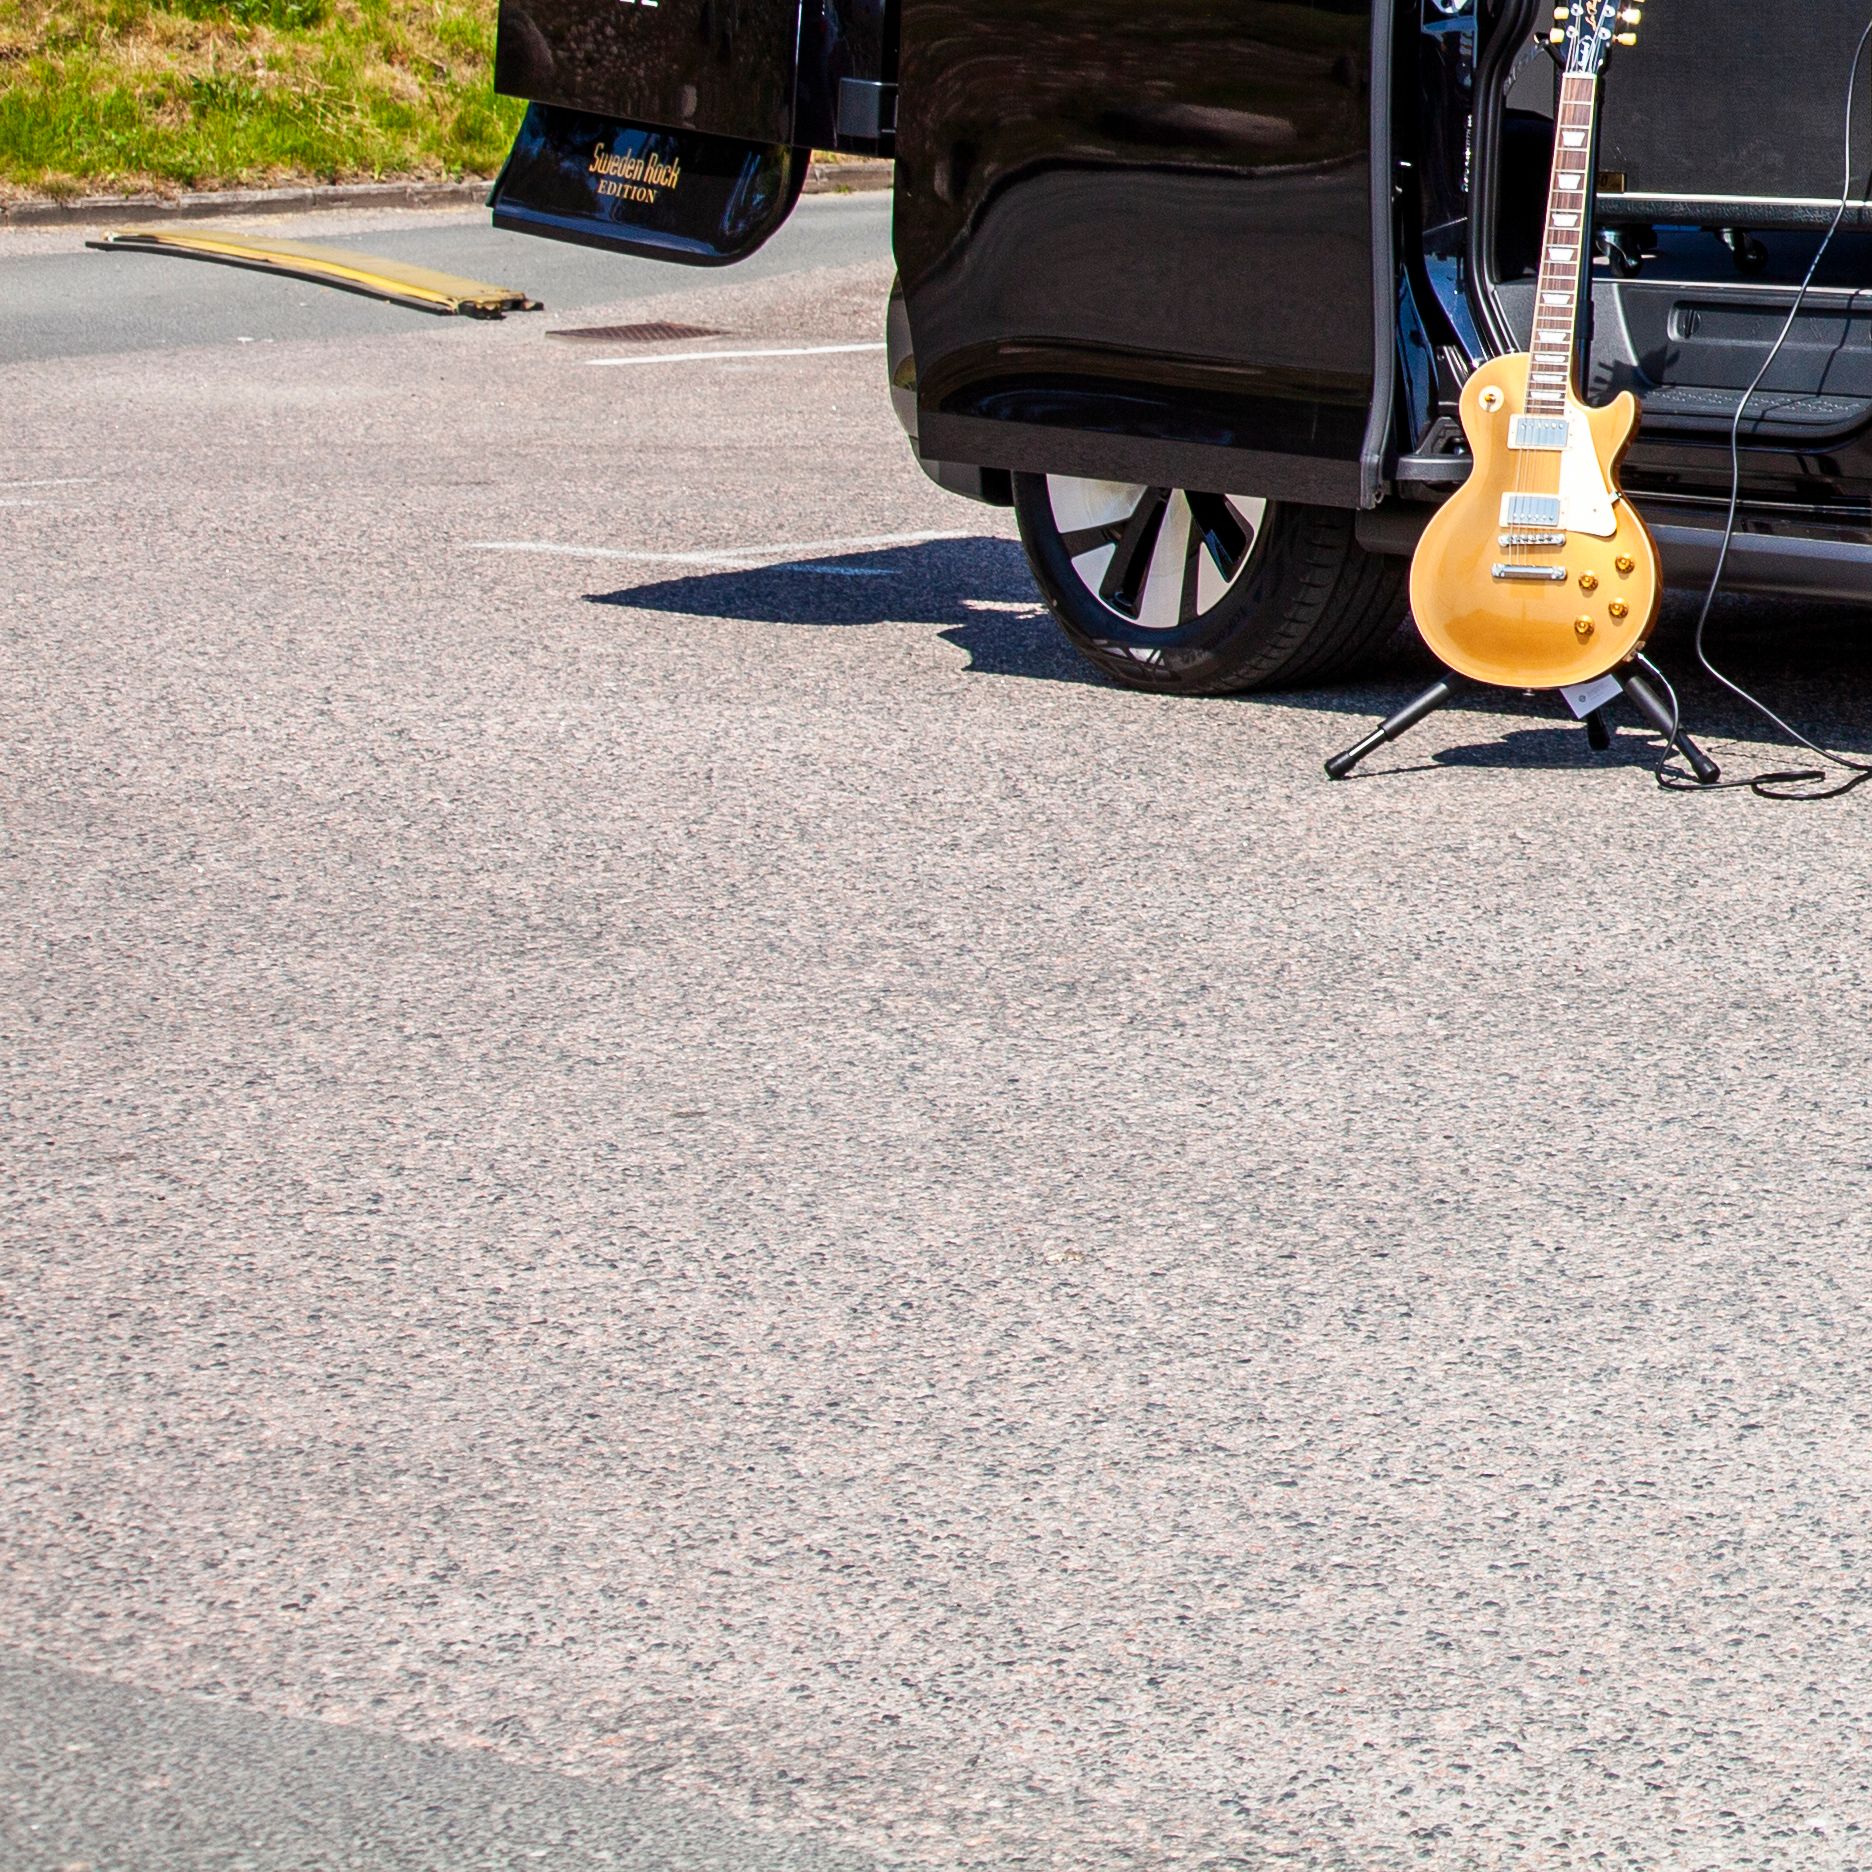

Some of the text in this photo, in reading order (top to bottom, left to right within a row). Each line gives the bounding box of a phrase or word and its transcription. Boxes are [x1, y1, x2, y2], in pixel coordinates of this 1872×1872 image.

[588, 141, 681, 190] Sweden Rock
[597, 178, 658, 204] EDITION
